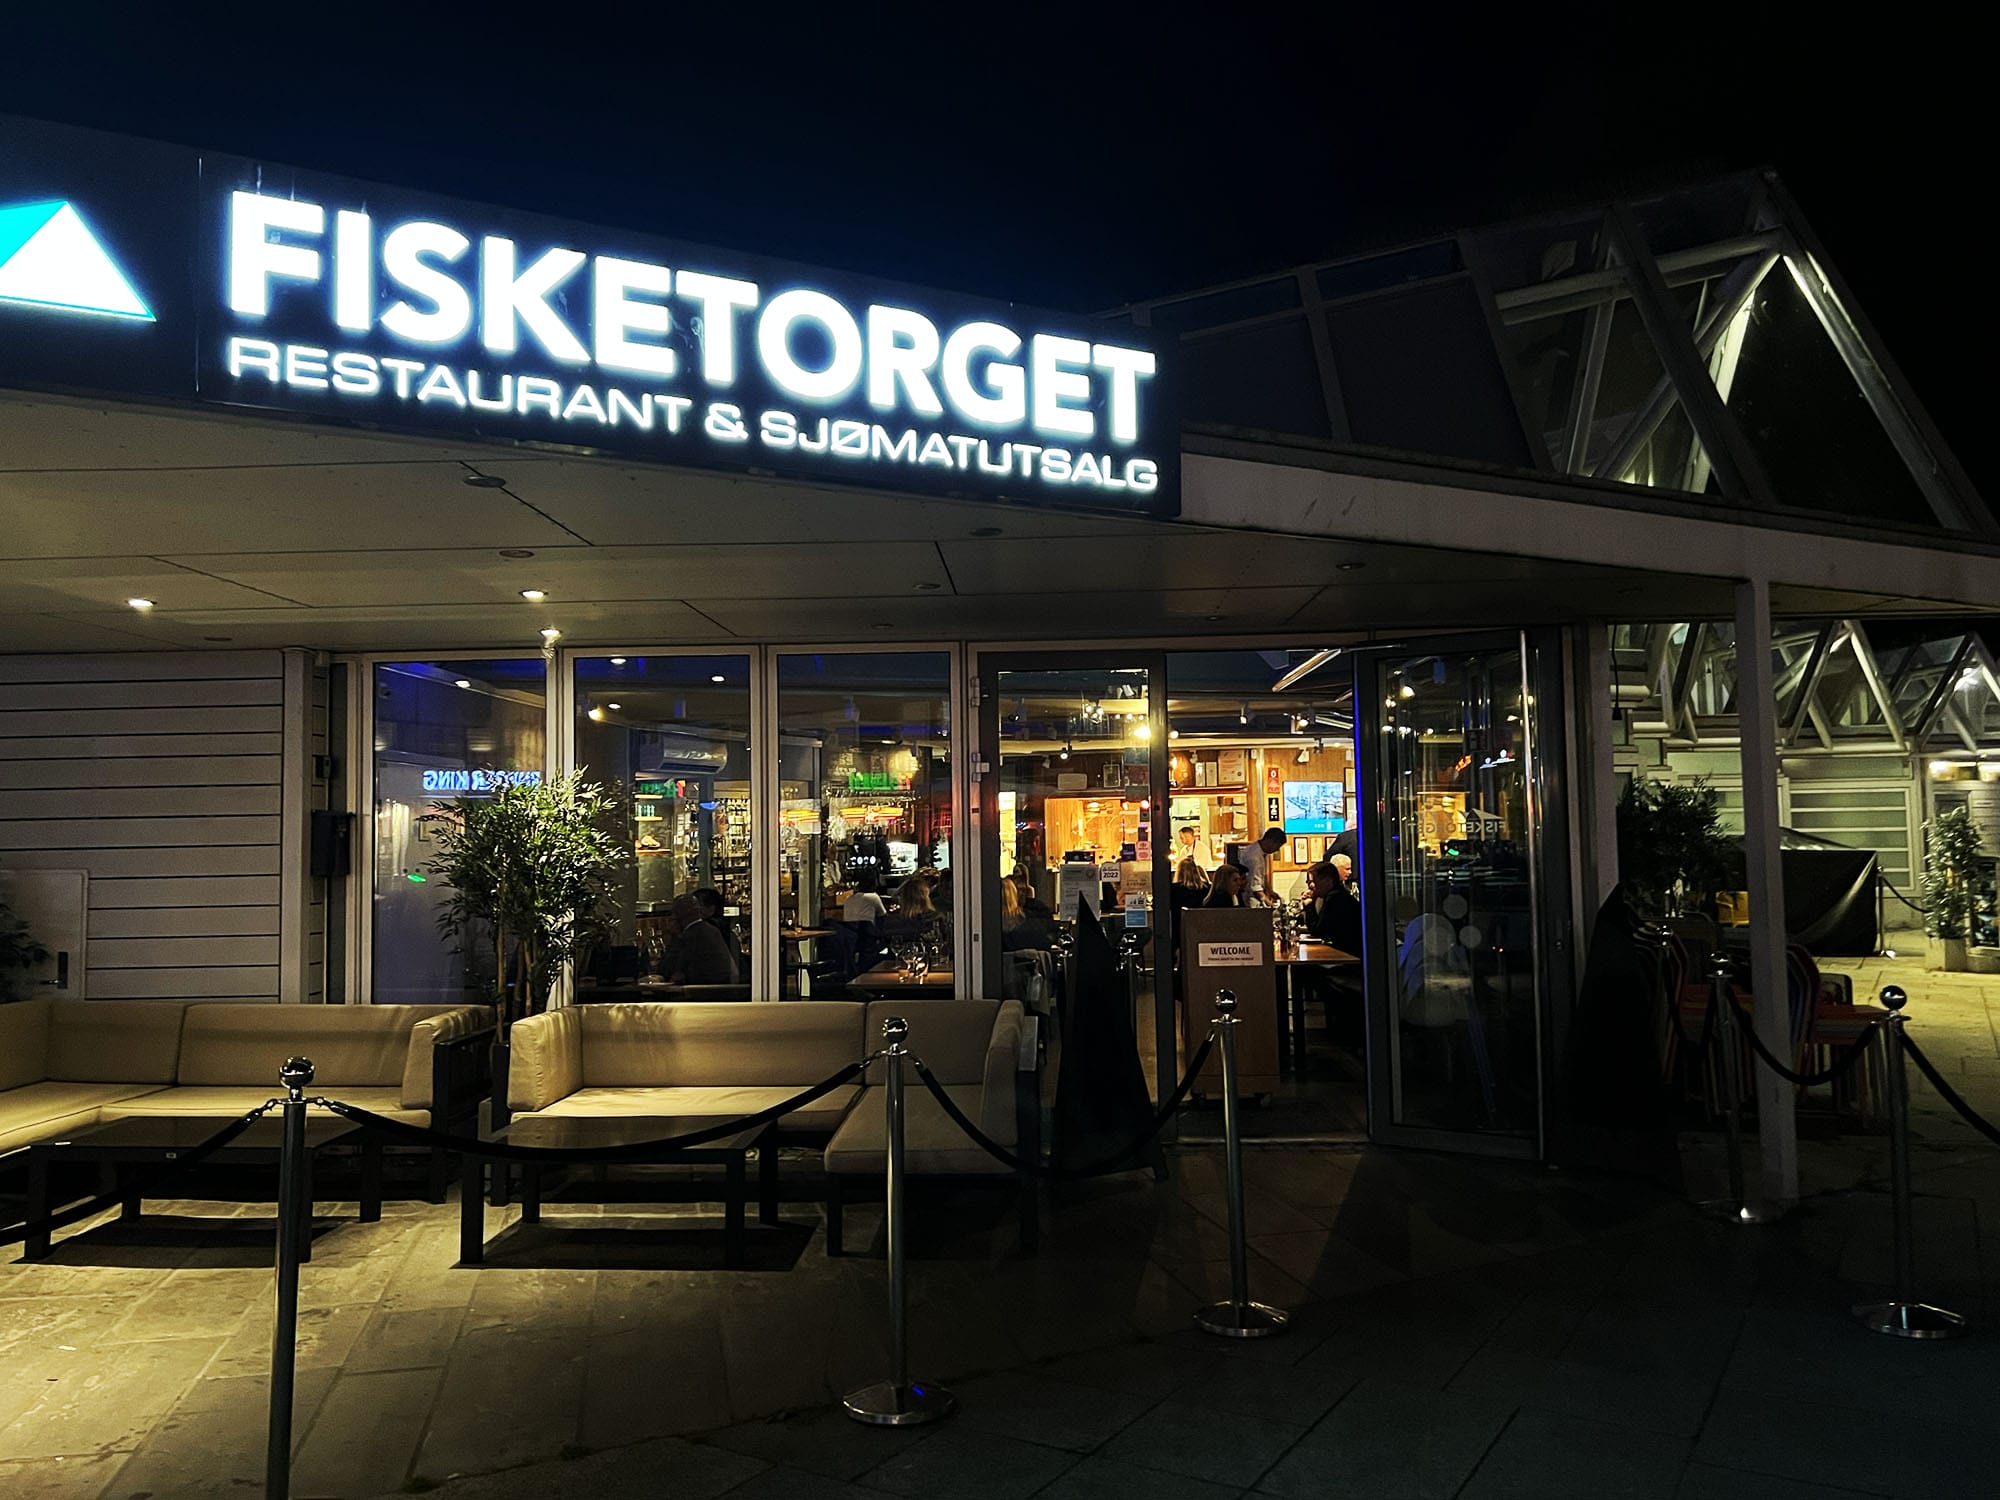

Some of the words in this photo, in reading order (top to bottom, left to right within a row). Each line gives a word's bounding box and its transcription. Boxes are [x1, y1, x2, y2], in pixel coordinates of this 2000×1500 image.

[228, 190, 1157, 444] FISKETORGET
[226, 336, 692, 434] RESTAURANT
[704, 402, 749, 442] &
[759, 410, 1159, 493] SJØMATUTSALG
[1210, 946, 1251, 955] WELCOME
